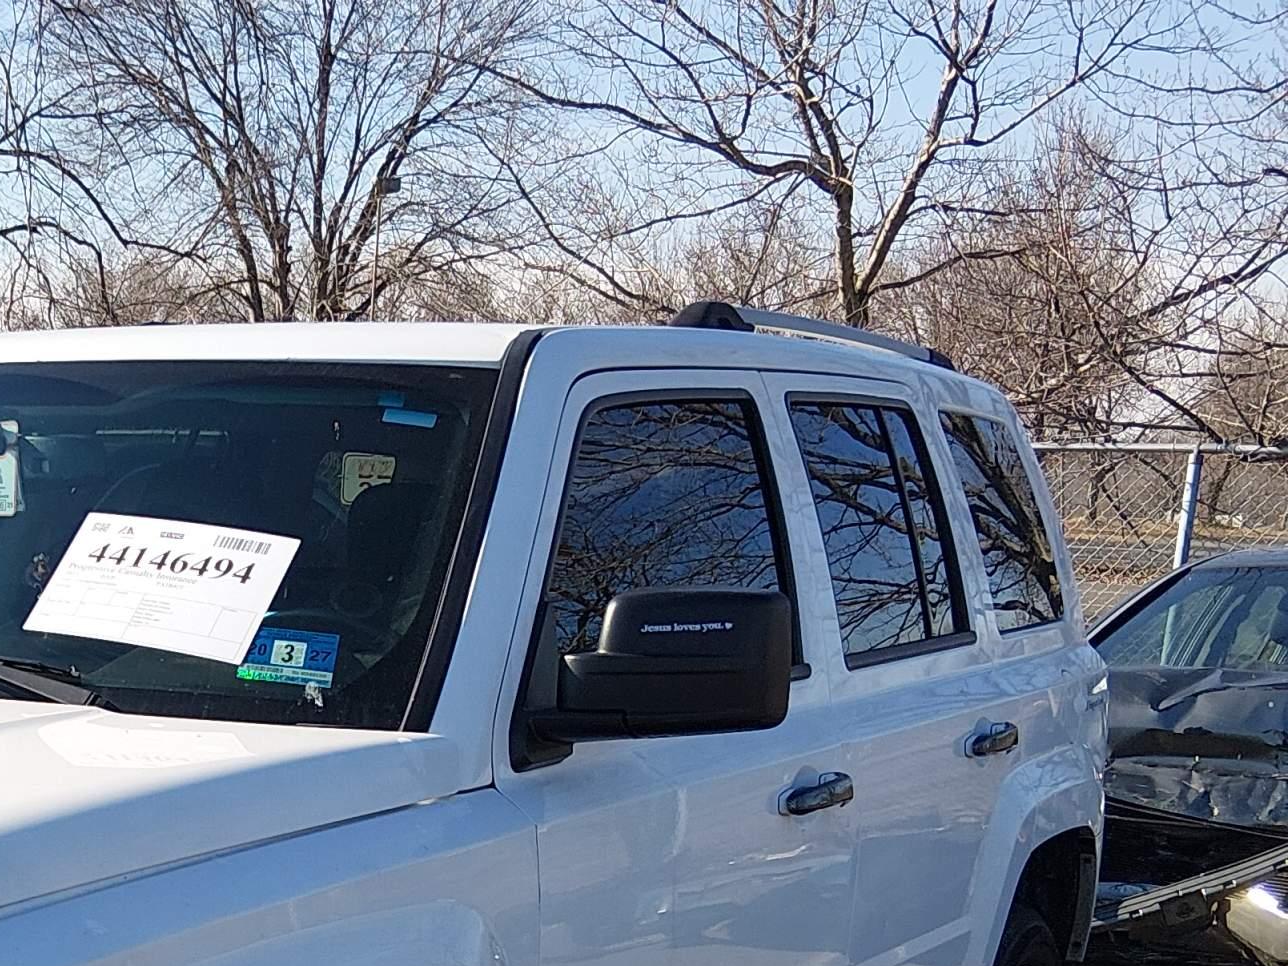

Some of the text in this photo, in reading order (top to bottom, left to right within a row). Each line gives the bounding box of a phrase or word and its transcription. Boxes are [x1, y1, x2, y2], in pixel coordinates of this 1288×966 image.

[87, 542, 256, 585] 44146494
[640, 624, 672, 633] Jesus
[673, 622, 701, 632] loves
[281, 644, 295, 663] 3
[309, 649, 332, 662] 27
